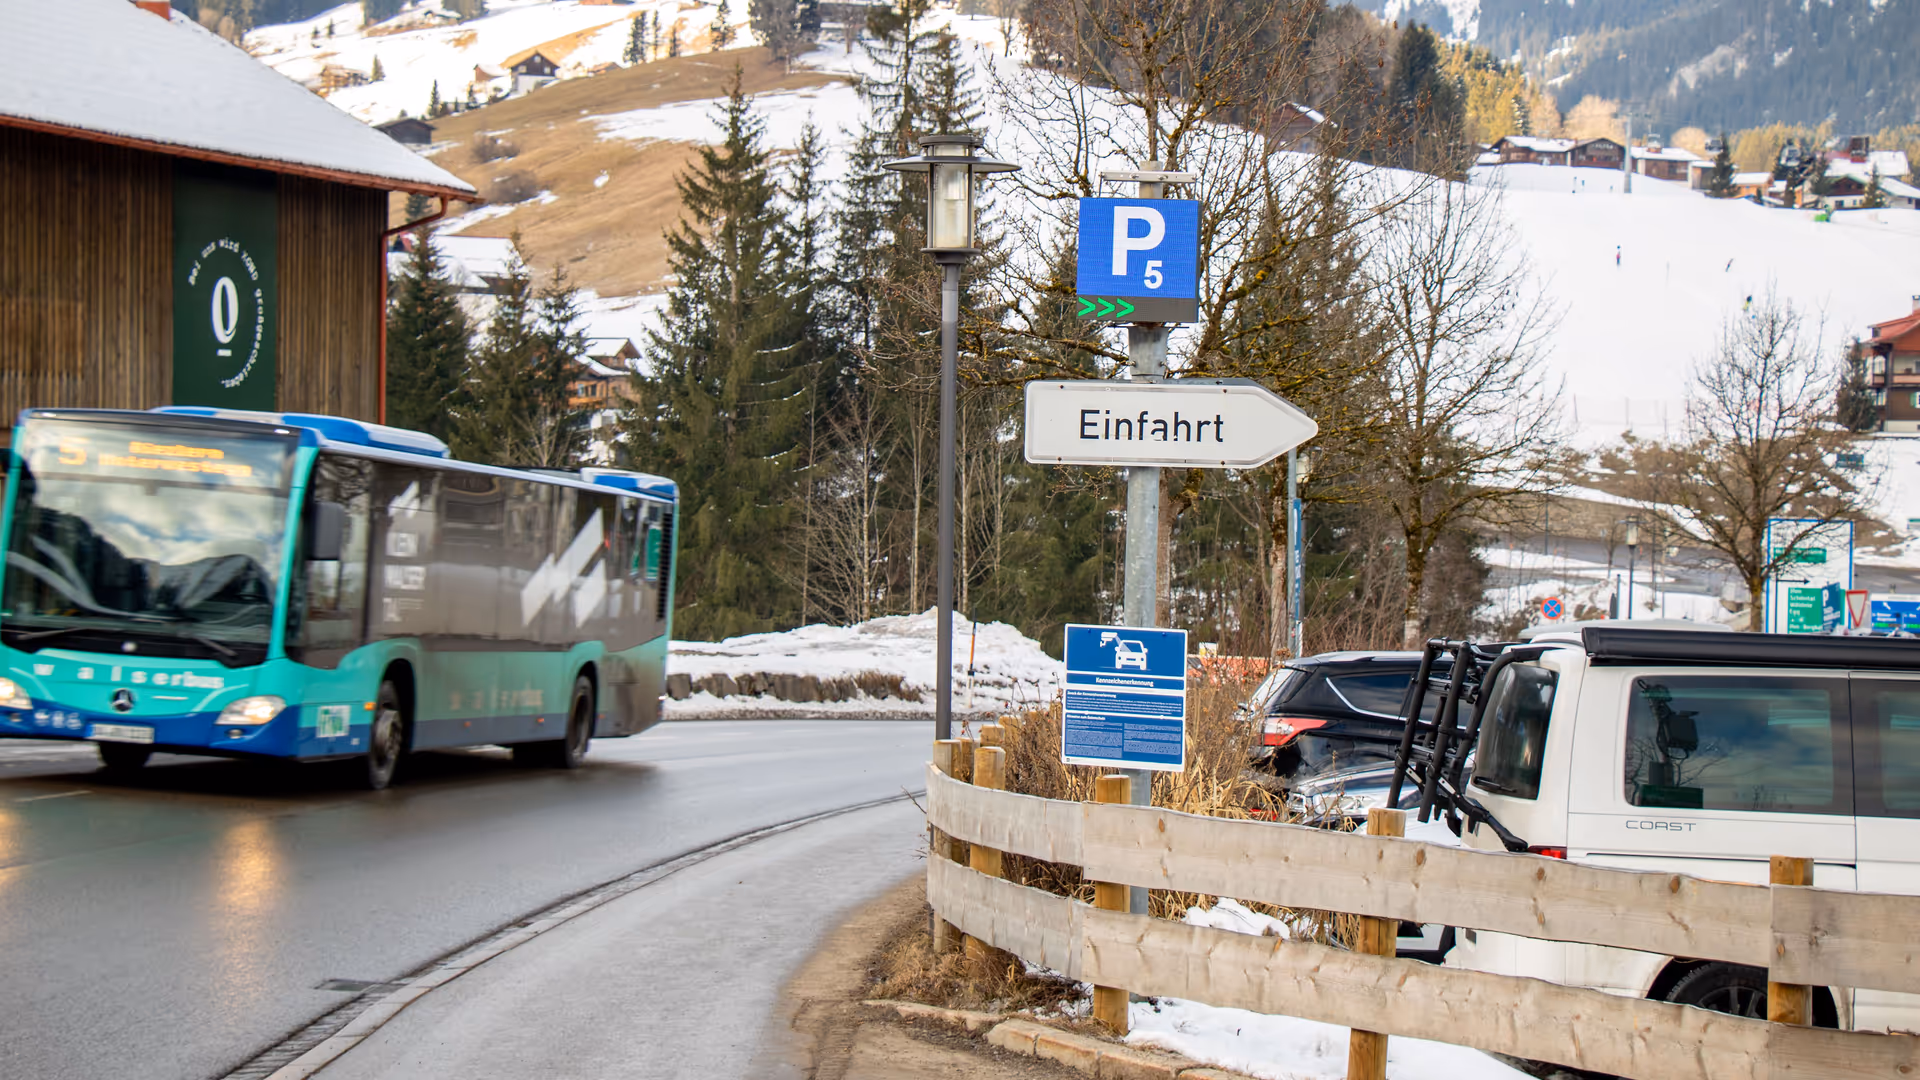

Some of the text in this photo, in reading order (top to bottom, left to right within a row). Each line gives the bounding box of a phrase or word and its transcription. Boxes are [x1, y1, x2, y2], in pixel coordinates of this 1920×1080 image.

[1112, 206, 1166, 289] P 5
[1080, 409, 1224, 442] Einfahrt
[59, 437, 88, 465] 5
[1625, 820, 1697, 831] COAST
